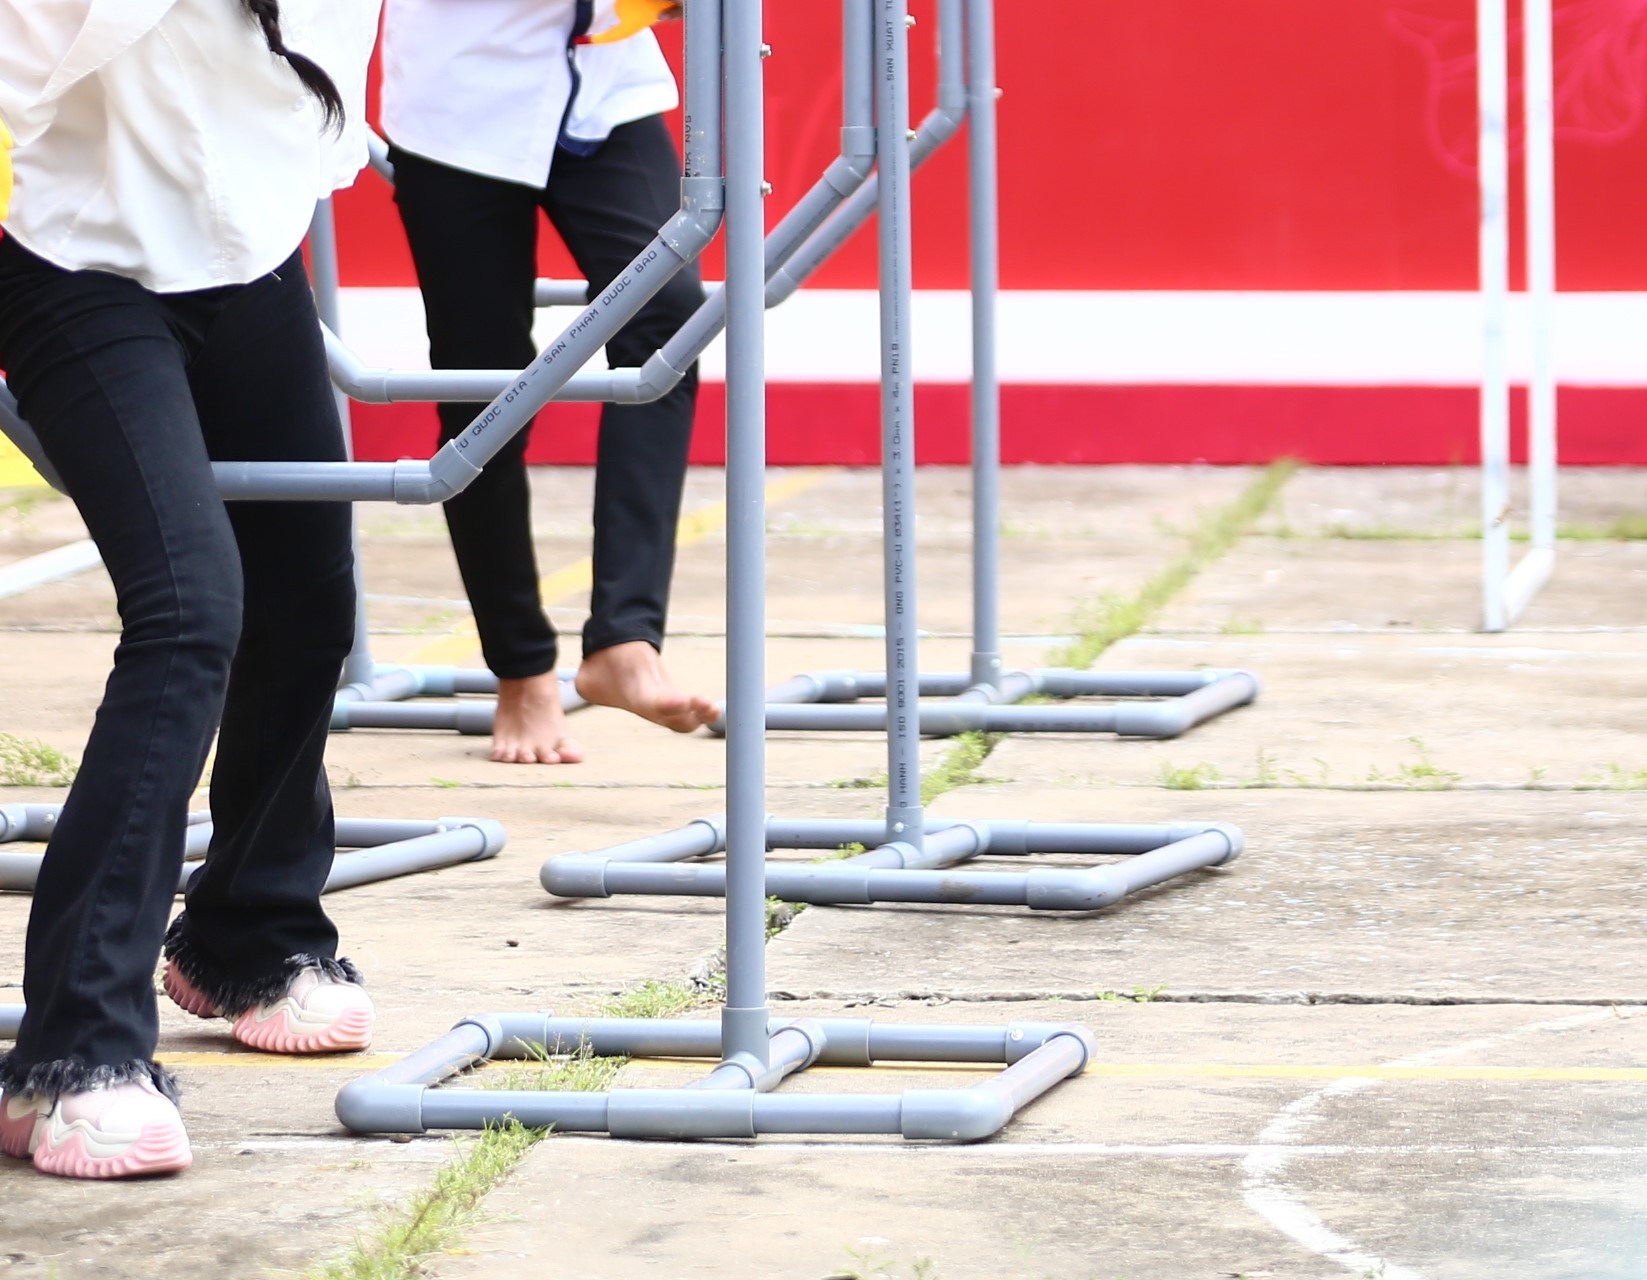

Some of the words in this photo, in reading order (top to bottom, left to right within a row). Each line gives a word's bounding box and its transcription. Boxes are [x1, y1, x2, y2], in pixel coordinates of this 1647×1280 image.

[886, 20, 894, 50] XUAT
[886, 57, 894, 81] SAN
[472, 405, 502, 437] QUOC
[505, 380, 528, 404] GIA
[543, 340, 567, 366] SAN
[569, 308, 600, 339] PHAM
[602, 275, 632, 306] DUOC
[634, 249, 658, 274] BAO
[894, 544, 903, 583] PVC-U
